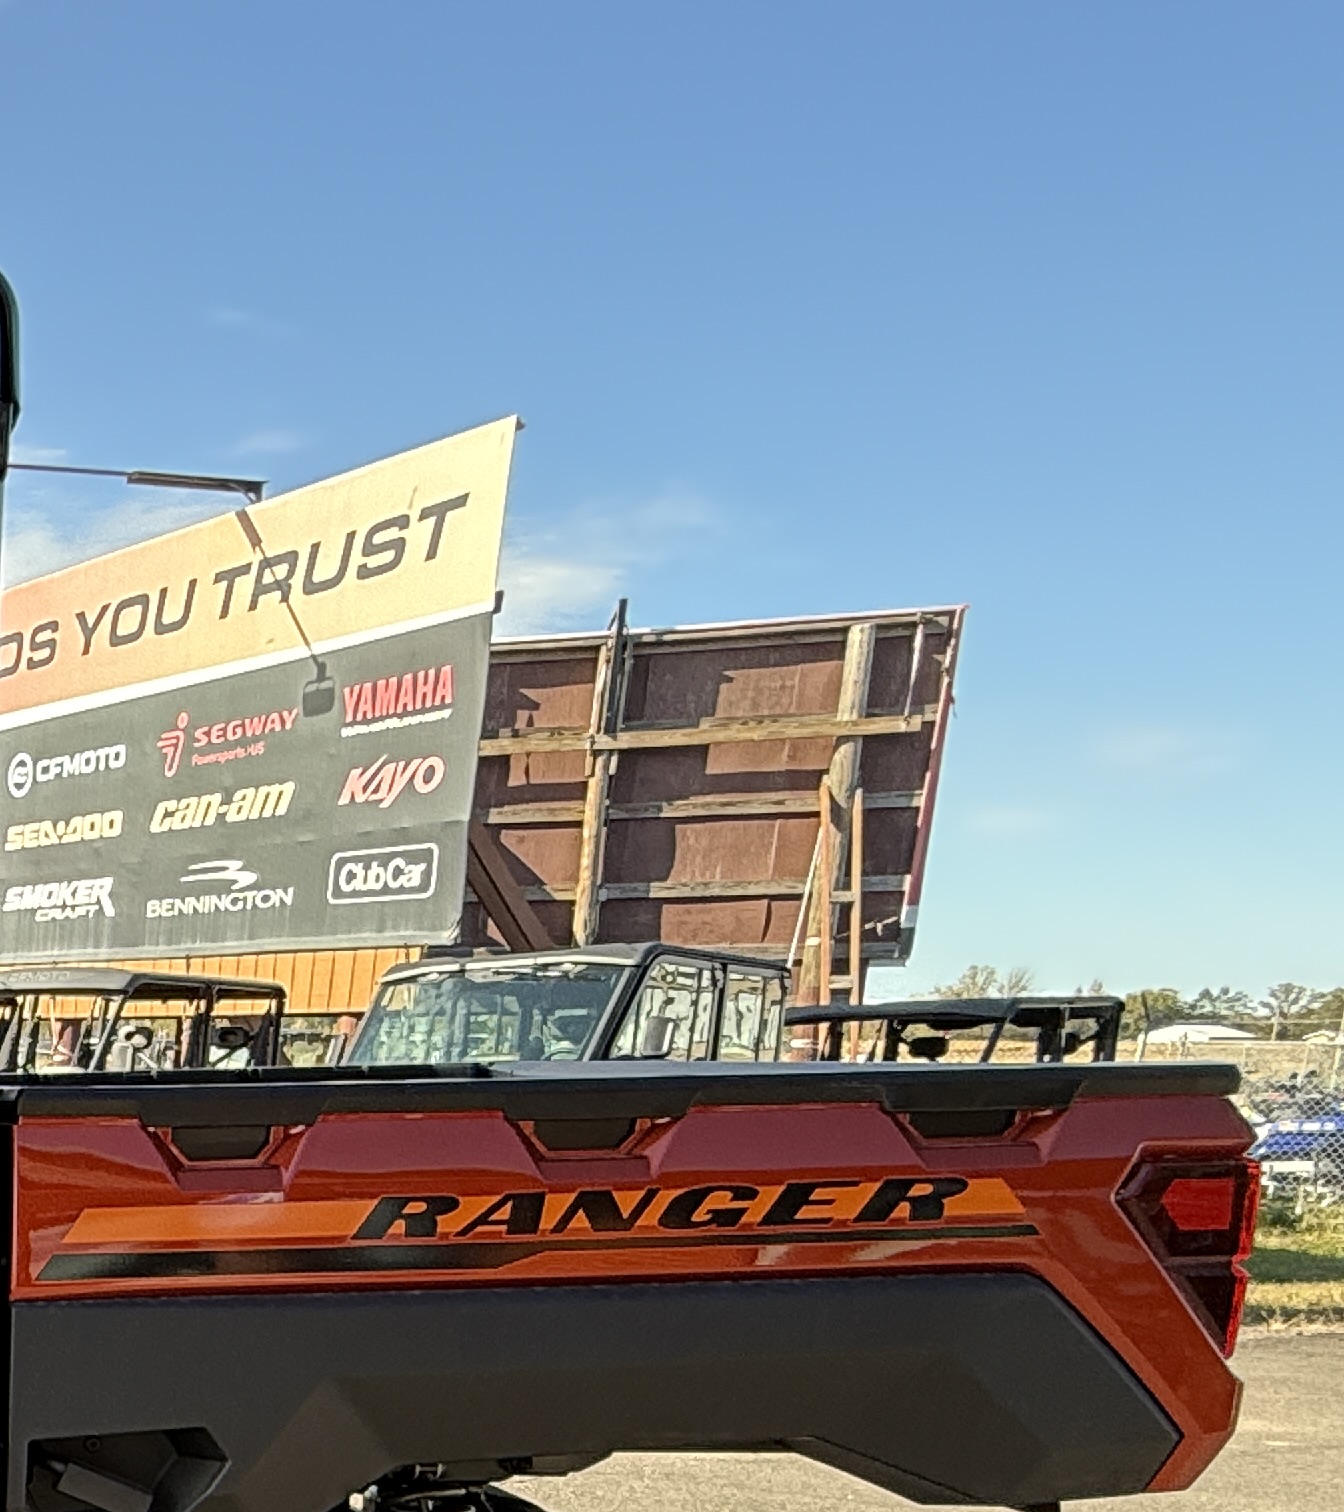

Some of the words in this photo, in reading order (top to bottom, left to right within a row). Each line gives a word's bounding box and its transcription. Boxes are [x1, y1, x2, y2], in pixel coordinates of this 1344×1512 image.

[75, 578, 197, 656] YOU
[212, 492, 470, 619] TRUST
[343, 664, 453, 723] YAMAHA
[192, 707, 298, 748] SEGWAY
[35, 744, 127, 782] CFMOTO
[2, 876, 115, 918] SMOKER
[34, 904, 100, 922] CRAFT
[145, 886, 295, 919] BENNINGTON
[349, 1176, 971, 1241] RANGER
